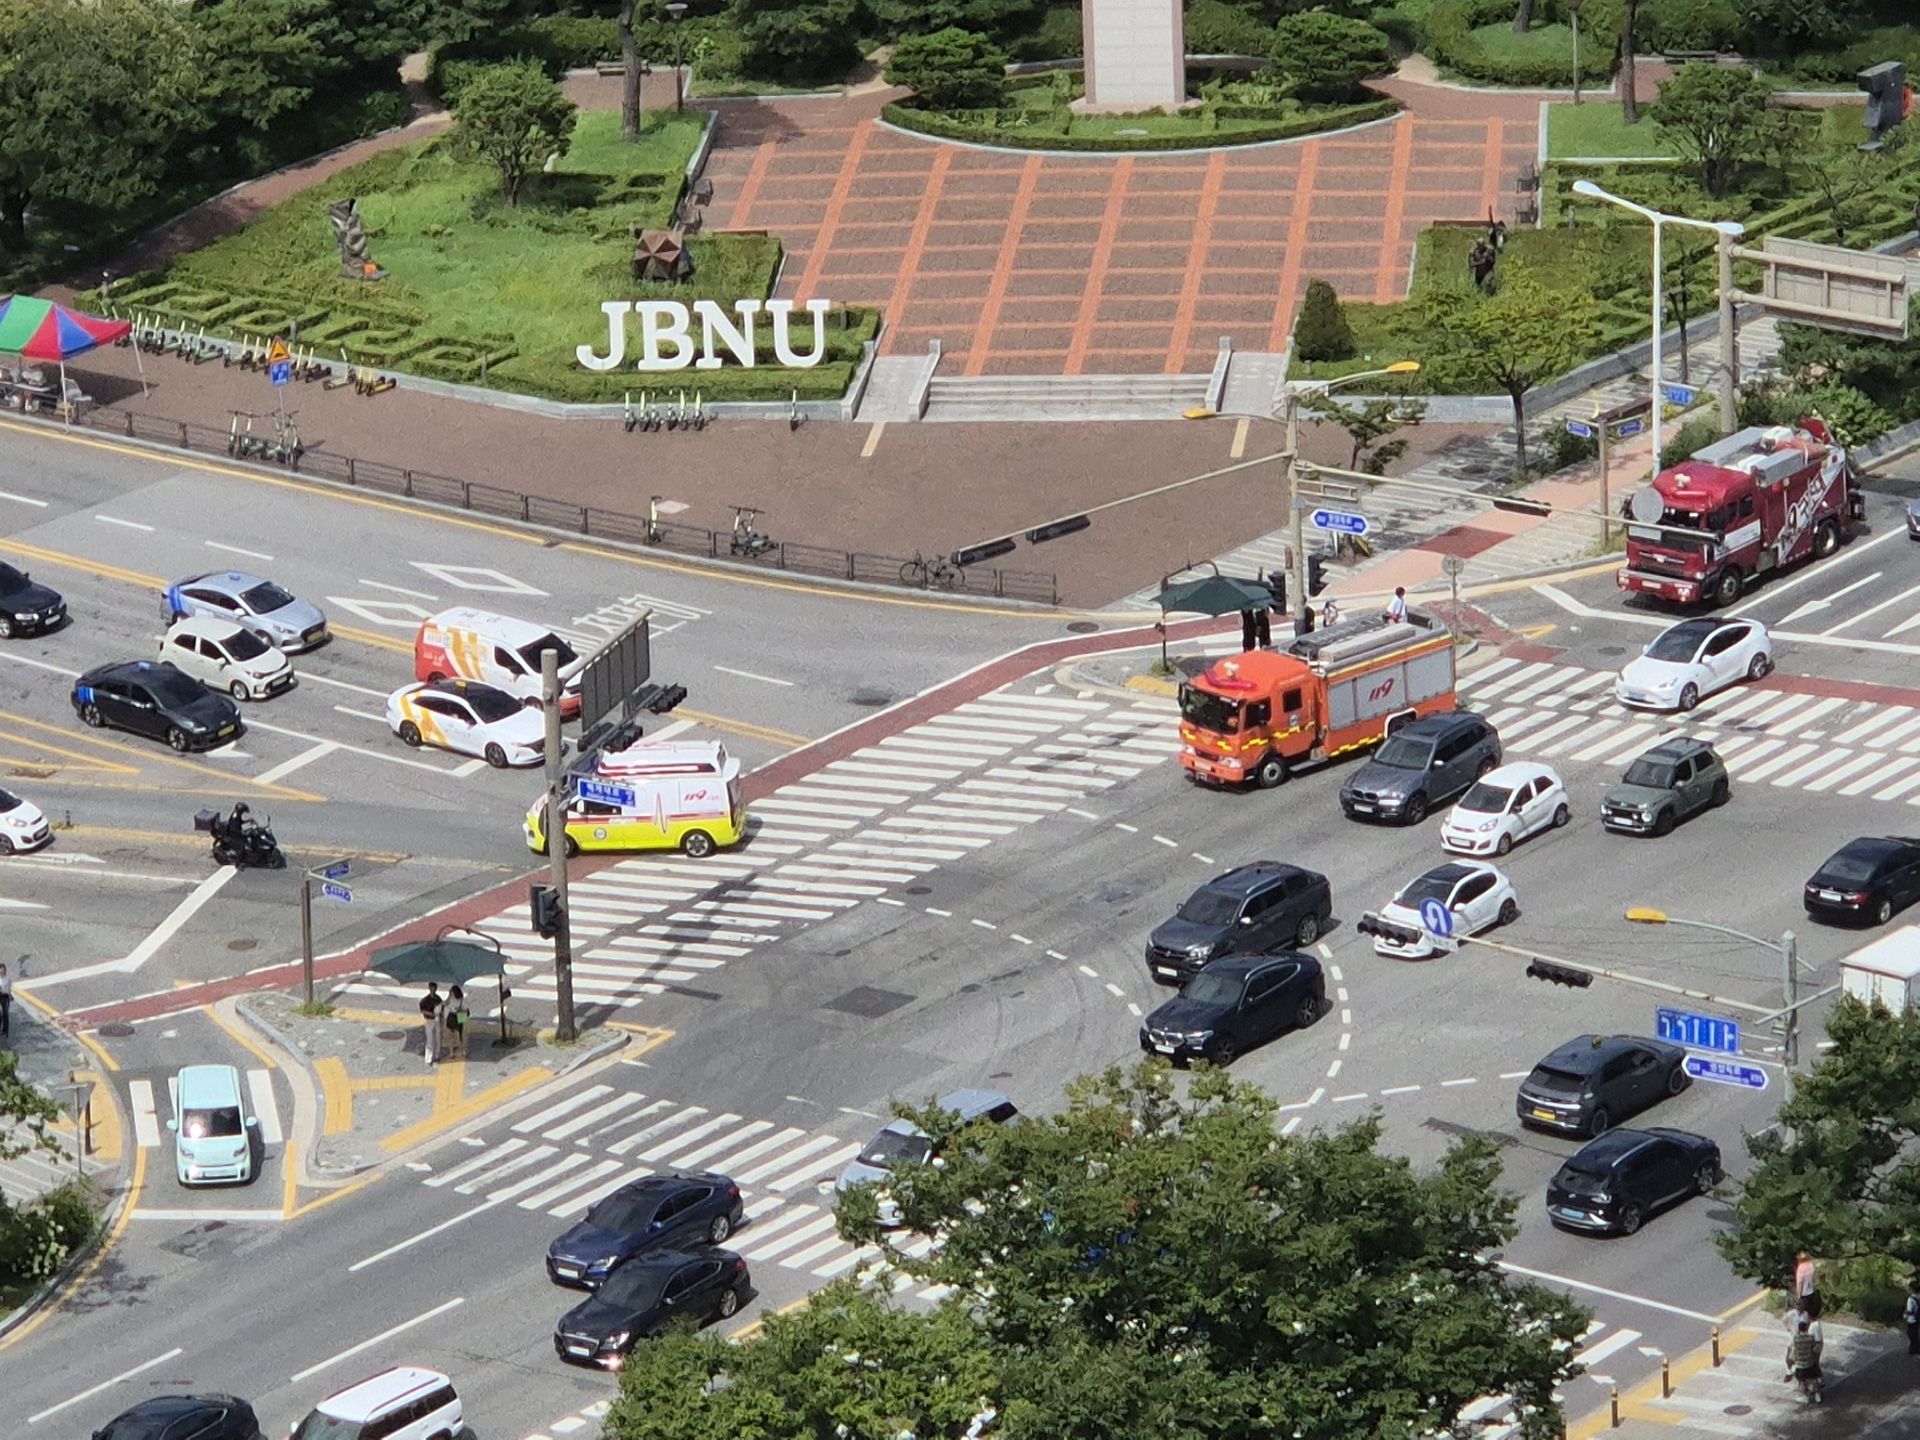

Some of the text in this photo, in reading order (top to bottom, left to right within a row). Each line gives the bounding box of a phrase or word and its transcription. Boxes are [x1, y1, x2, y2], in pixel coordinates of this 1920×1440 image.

[576, 299, 831, 371] JBNU
[1368, 677, 1394, 702] 119
[684, 789, 707, 801] 119
